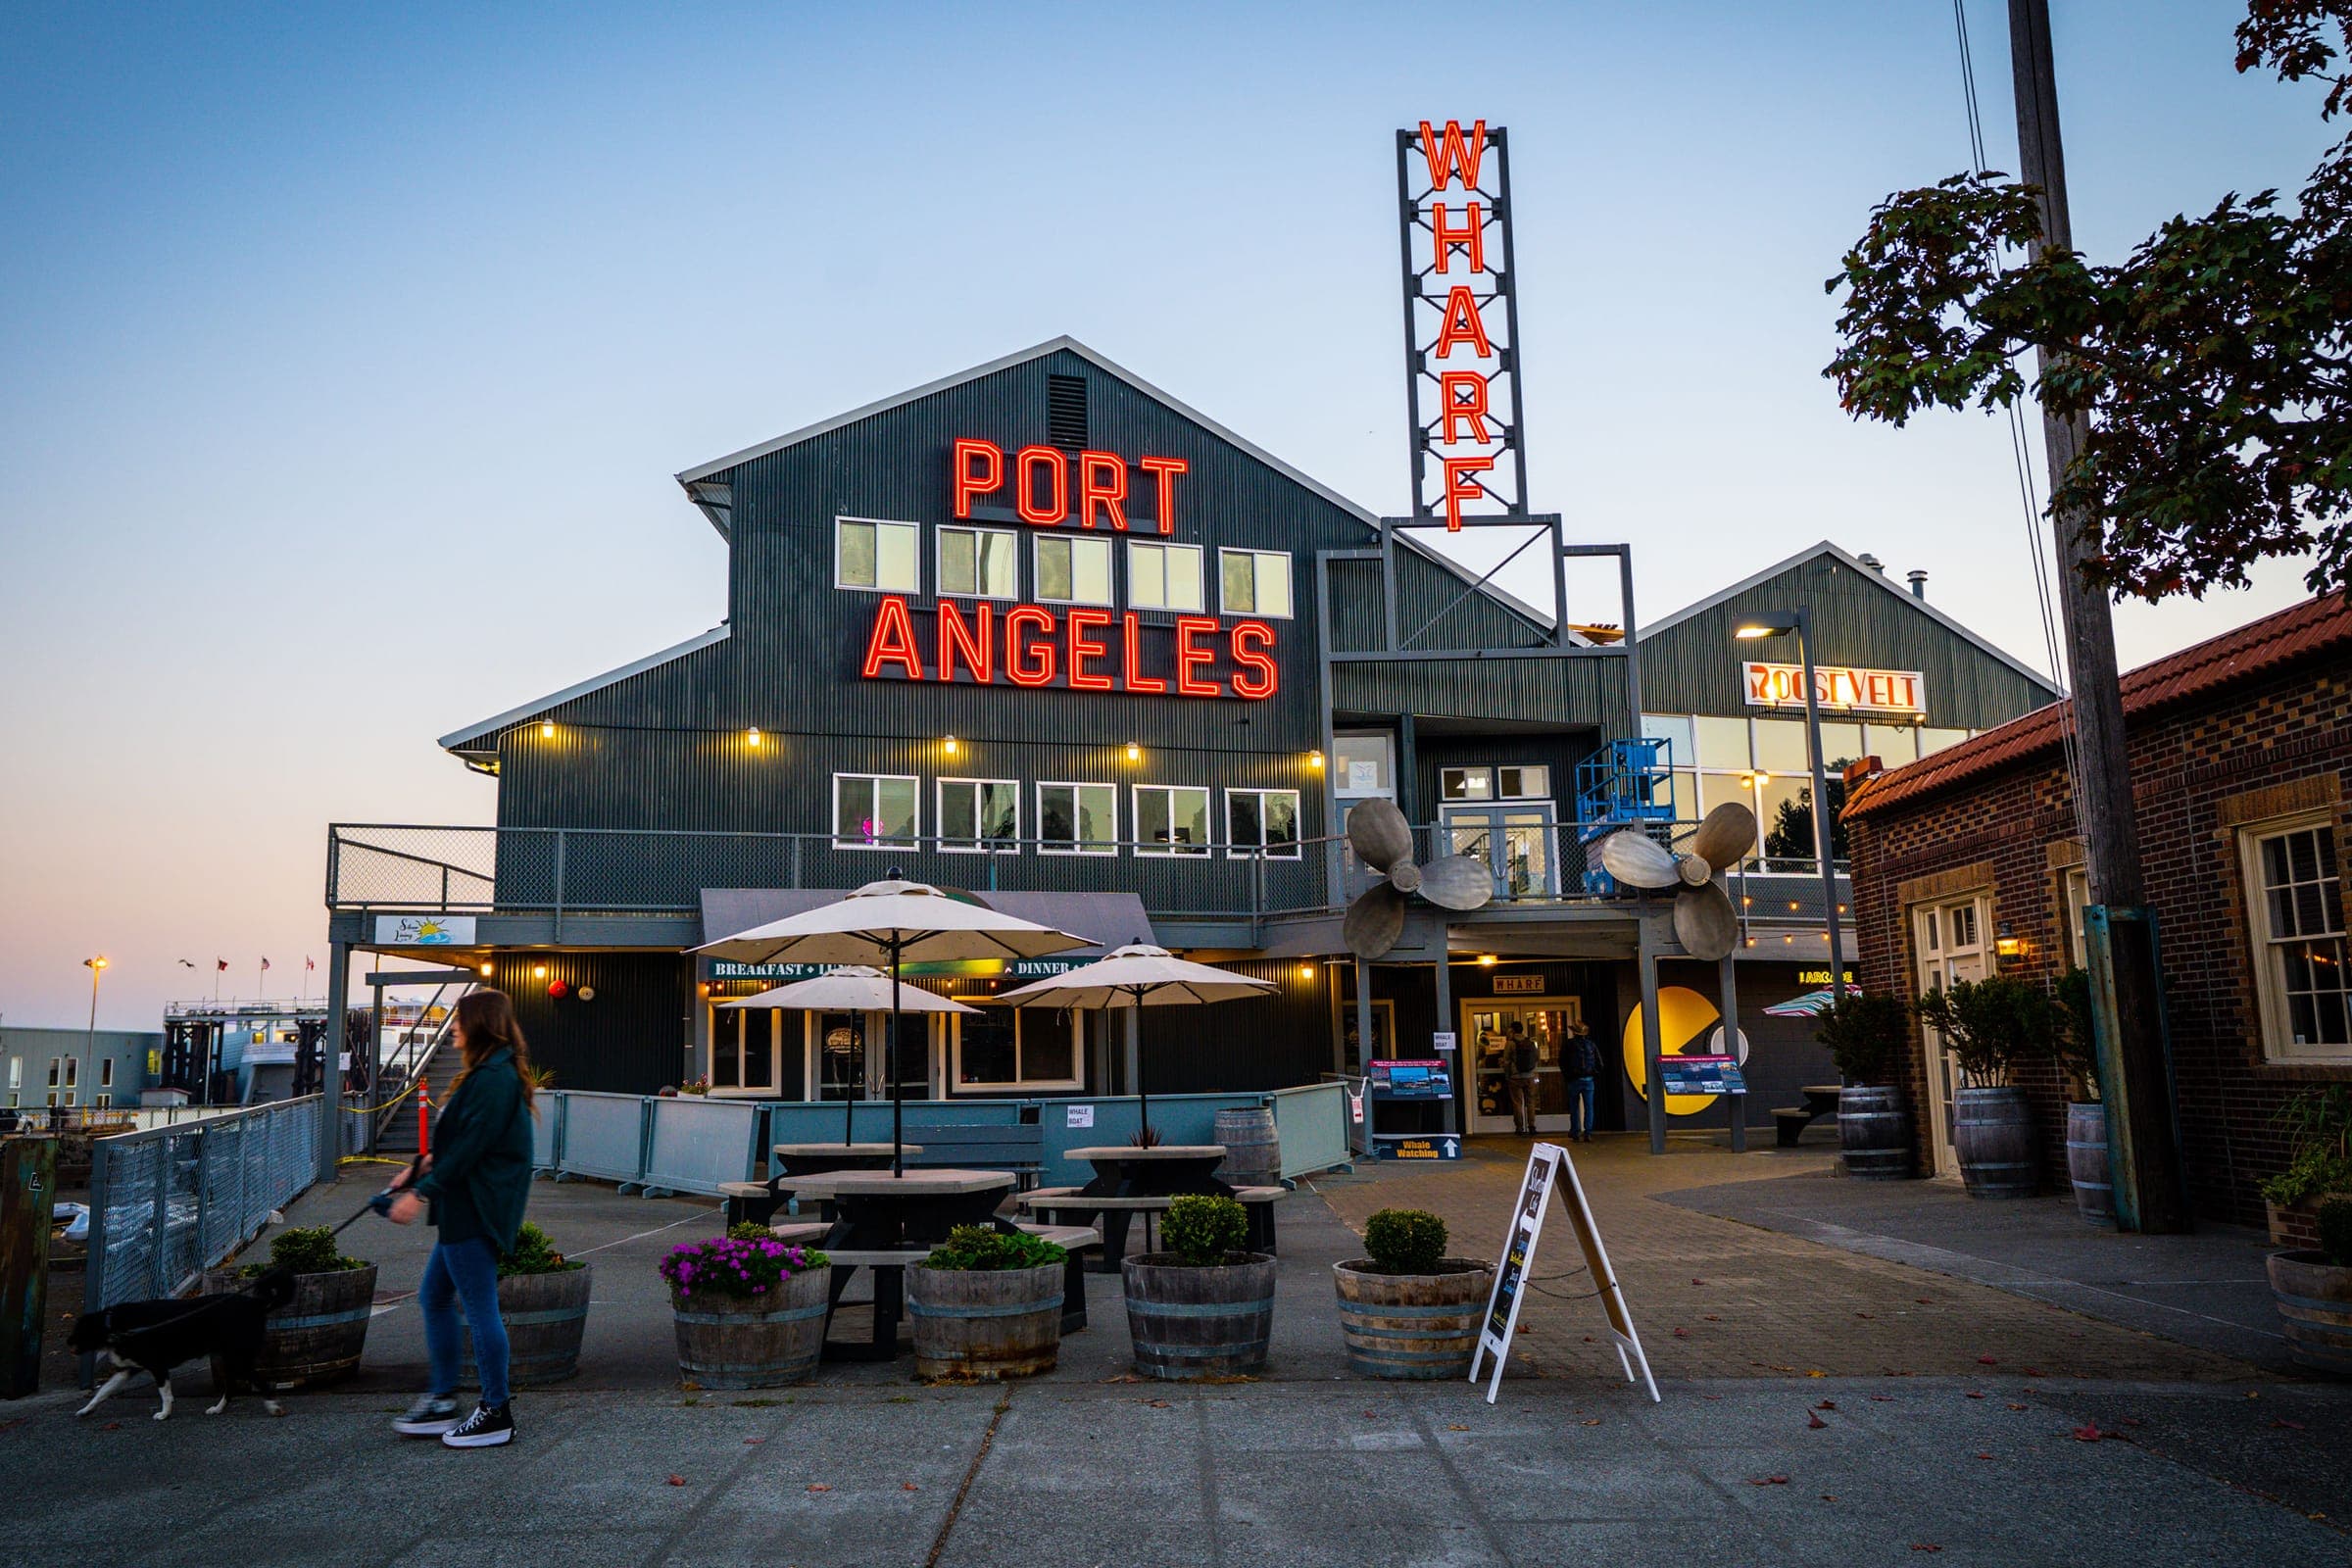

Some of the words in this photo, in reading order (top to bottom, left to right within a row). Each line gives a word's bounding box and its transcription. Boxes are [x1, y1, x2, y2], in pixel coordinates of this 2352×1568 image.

[1419, 120, 1494, 532] WHARF
[955, 437, 1188, 536] PORT
[861, 595, 1278, 701] ANGELES
[715, 963, 804, 975] BREAKFAST
[1018, 961, 1069, 974] DINNER
[1806, 971, 1853, 984] ARCE
[1496, 980, 1542, 990] WHARF
[1403, 1141, 1431, 1150] Whale
[1396, 1150, 1439, 1158] Watching
